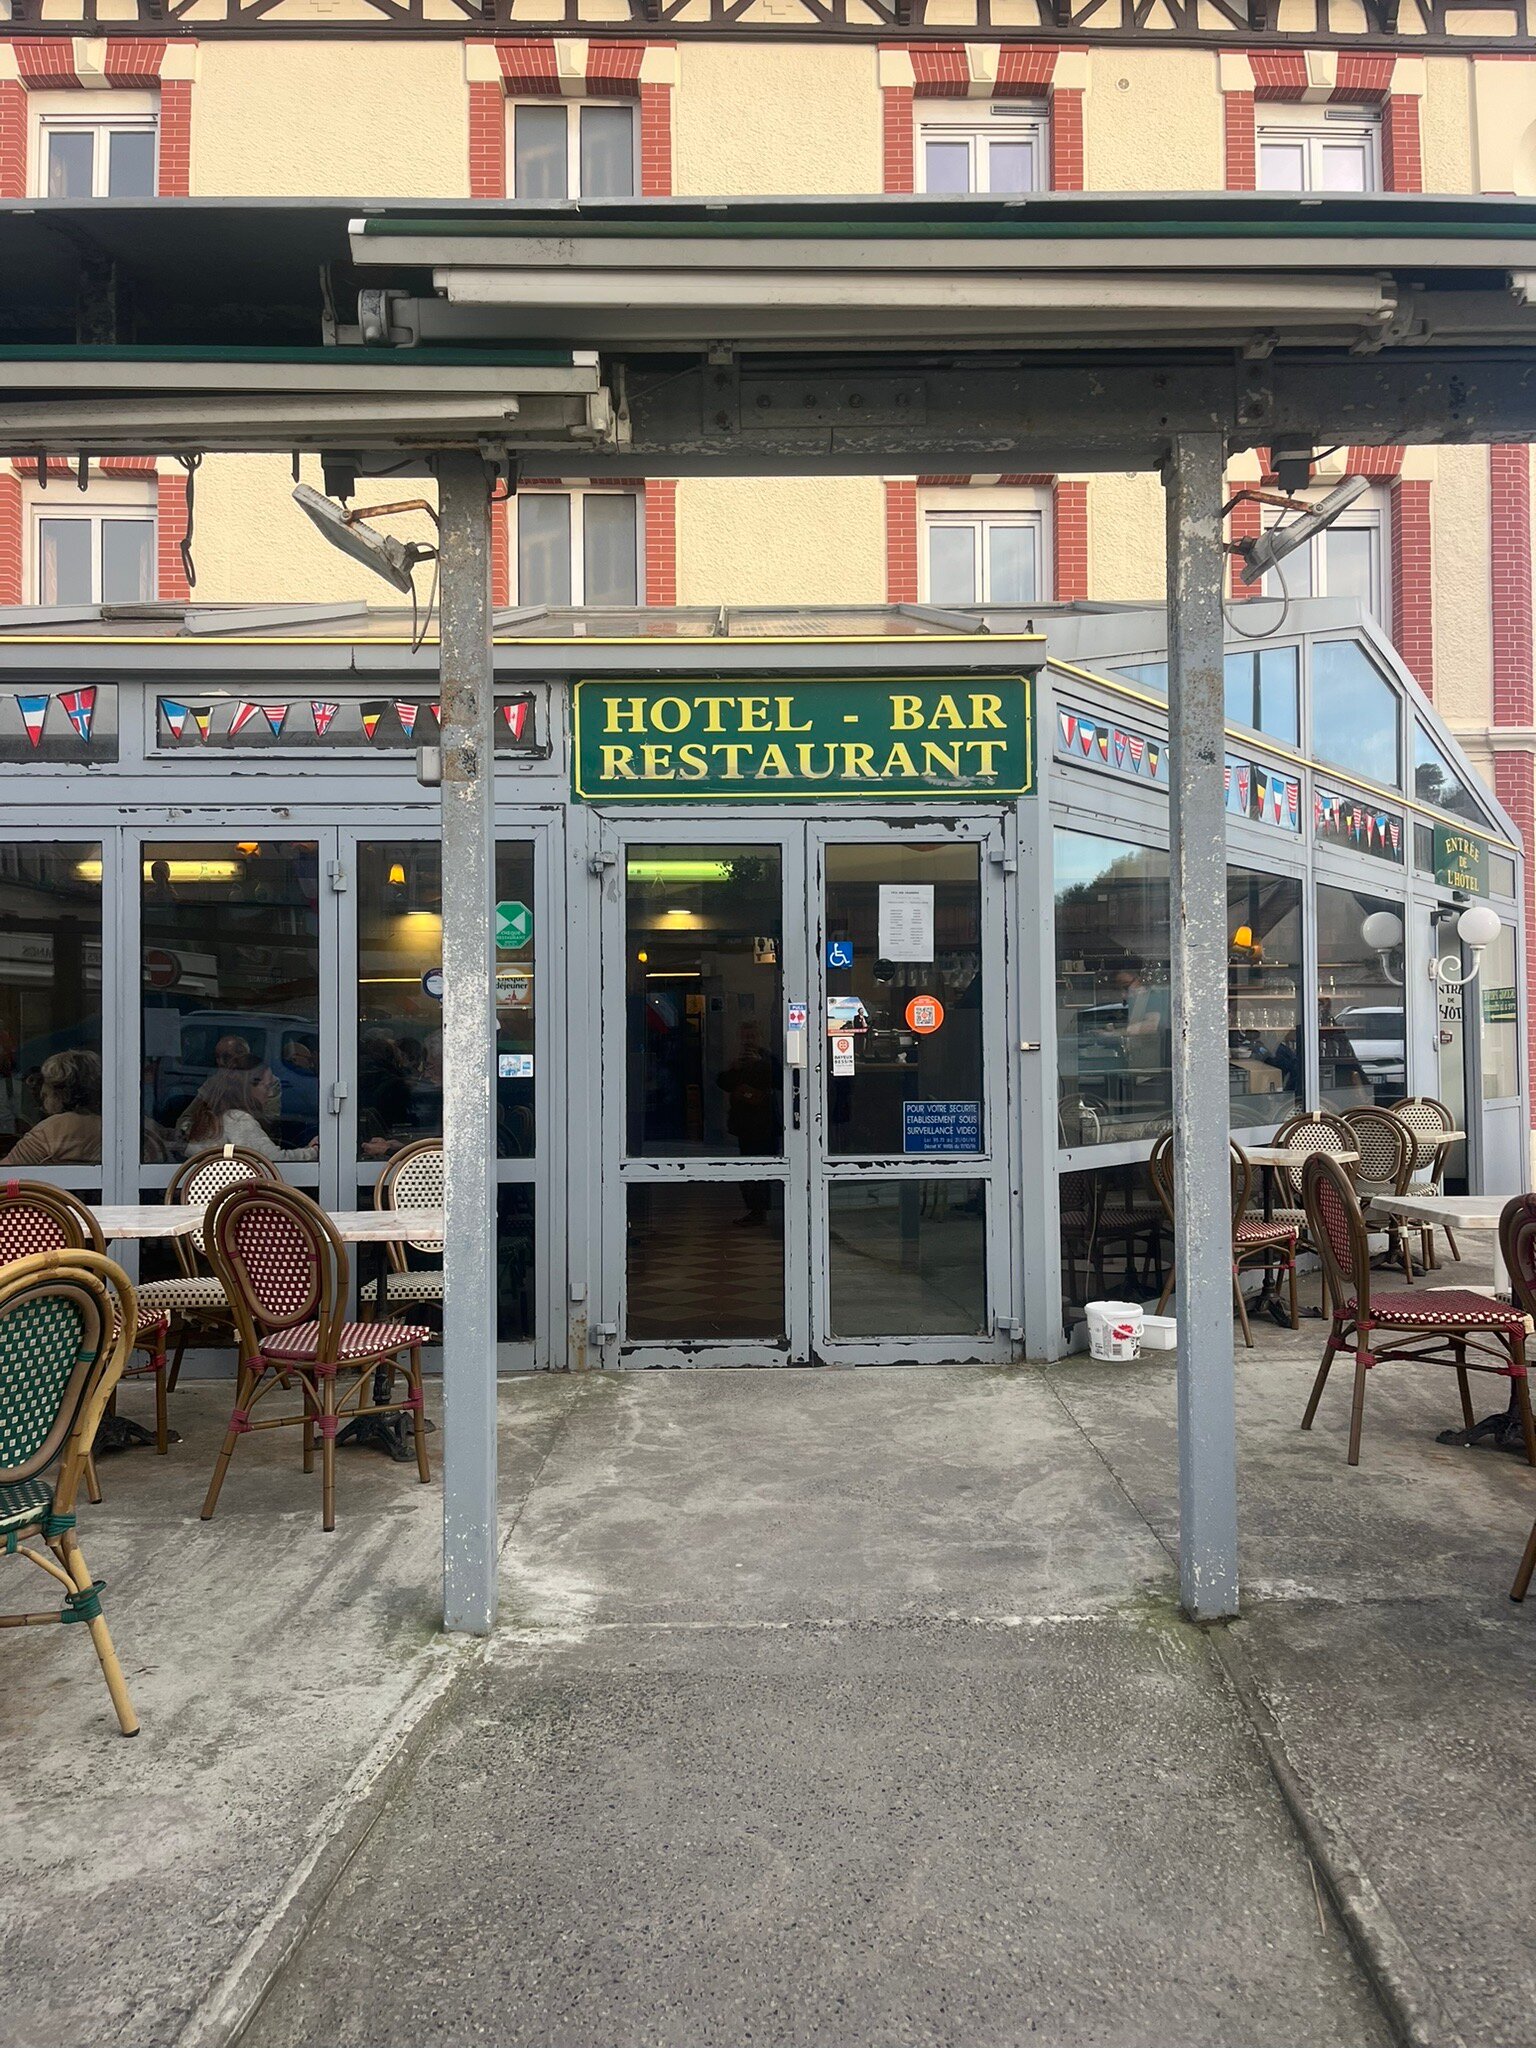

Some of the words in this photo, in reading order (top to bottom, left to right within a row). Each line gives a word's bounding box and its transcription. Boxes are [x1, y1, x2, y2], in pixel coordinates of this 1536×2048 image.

[602, 696, 814, 733] HOTEL
[889, 694, 1008, 730] BAR
[599, 741, 1008, 781] RESTAURANT
[1445, 836, 1480, 863] ENTRÉE
[1458, 855, 1468, 869] DE
[1447, 869, 1480, 892] L'HÔTEL
[496, 981, 528, 990] déjeuner
[906, 1104, 925, 1113] POUR
[926, 1104, 947, 1113] VOTRE
[949, 1104, 977, 1113] SECURITE
[906, 1115, 956, 1124] ETABLISSEMENT
[958, 1115, 977, 1124] SOUS
[906, 1126, 954, 1135] SURVEILLANCE
[956, 1126, 978, 1135] VIDEO
